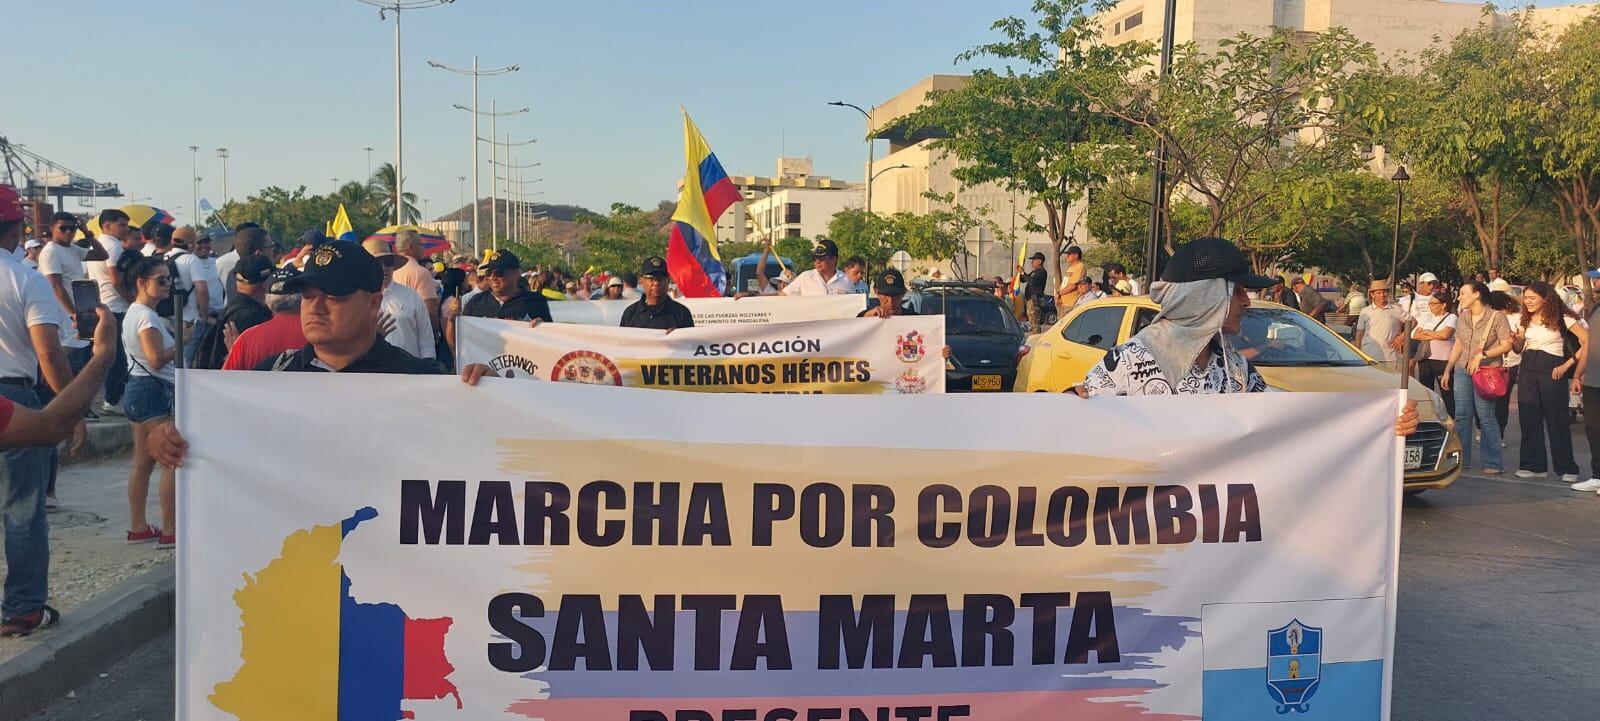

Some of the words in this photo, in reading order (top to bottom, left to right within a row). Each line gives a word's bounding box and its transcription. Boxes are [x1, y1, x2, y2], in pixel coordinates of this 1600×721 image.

[693, 336, 821, 357] ASOCIACIÓN
[640, 364, 776, 386] VETERANOS
[782, 359, 871, 383] HÉROES
[399, 479, 732, 548] MARCHA
[751, 482, 896, 549] POR
[917, 484, 1262, 549] COLOMBIA
[487, 592, 793, 673] SANTA
[817, 590, 1121, 672] MARTA
